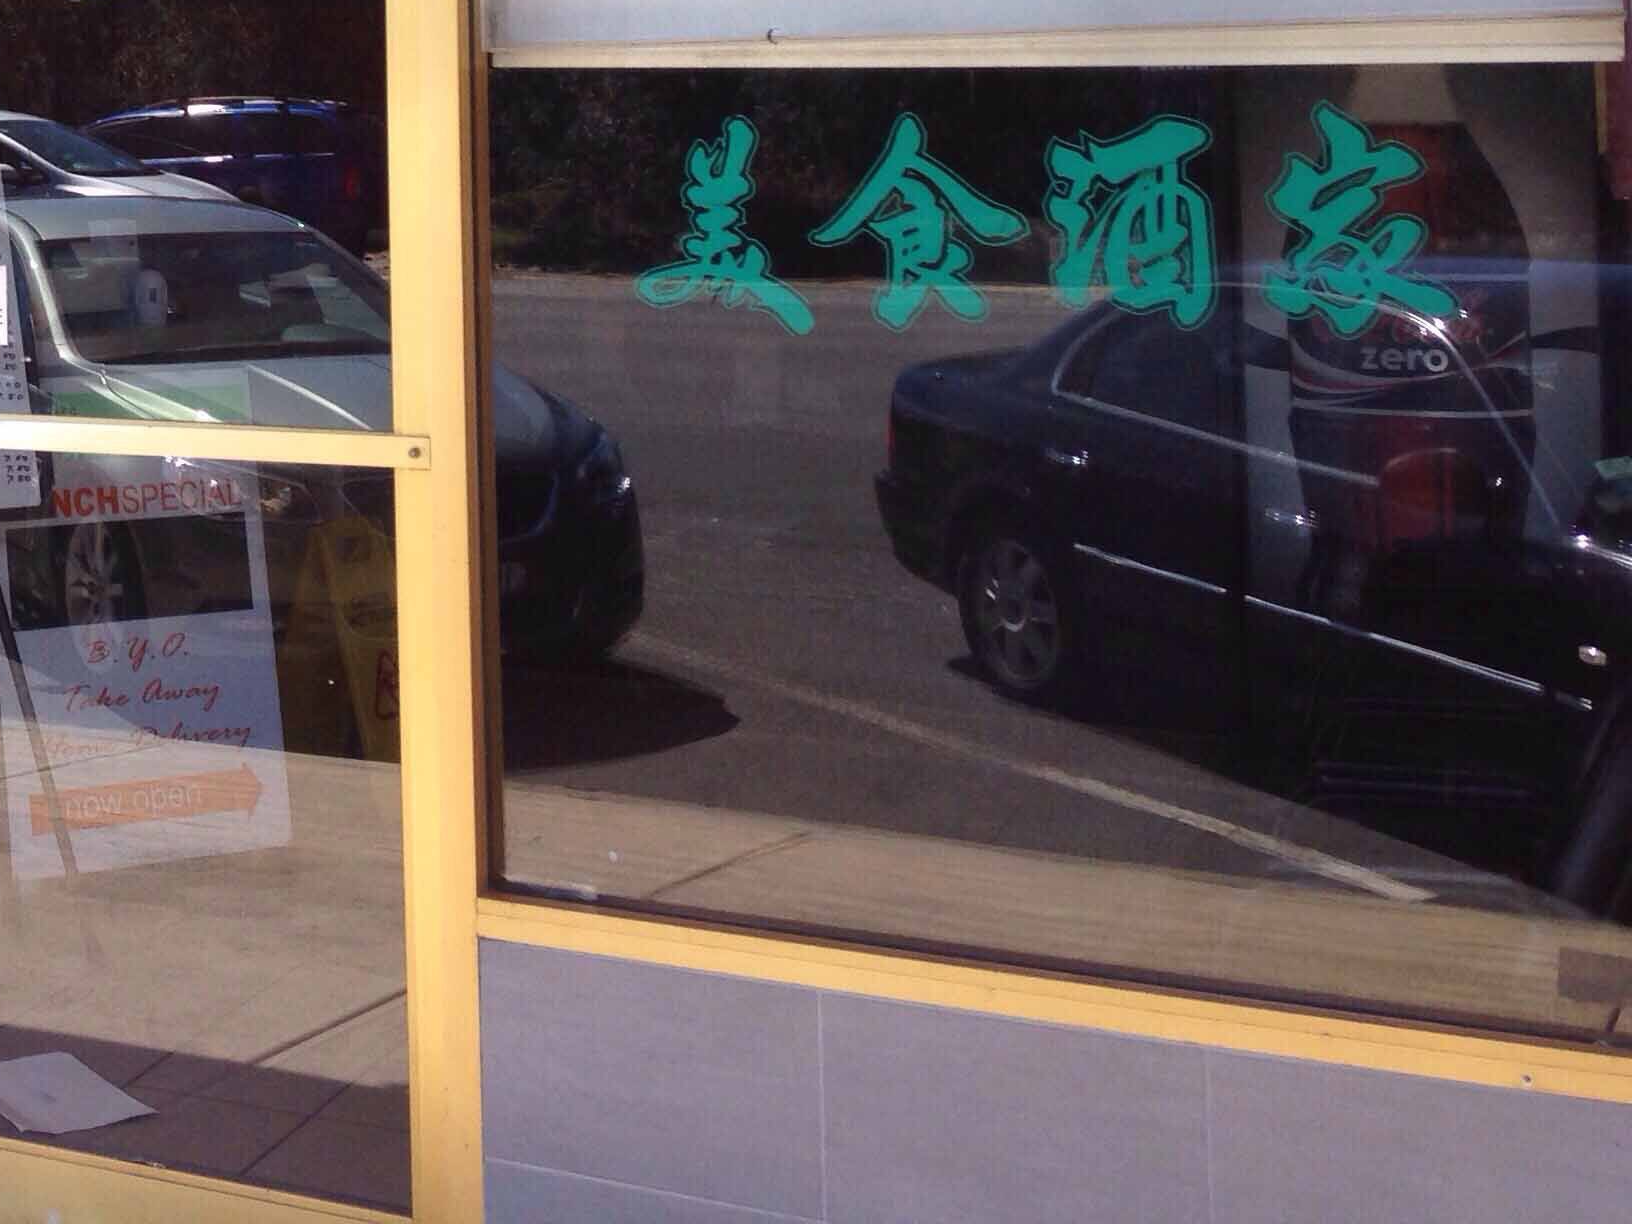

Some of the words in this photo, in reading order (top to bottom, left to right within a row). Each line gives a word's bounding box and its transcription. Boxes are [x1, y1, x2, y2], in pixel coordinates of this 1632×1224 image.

[634, 98, 1471, 340] 美食酒家
[1360, 343, 1450, 374] zero
[142, 677, 221, 713] Away
